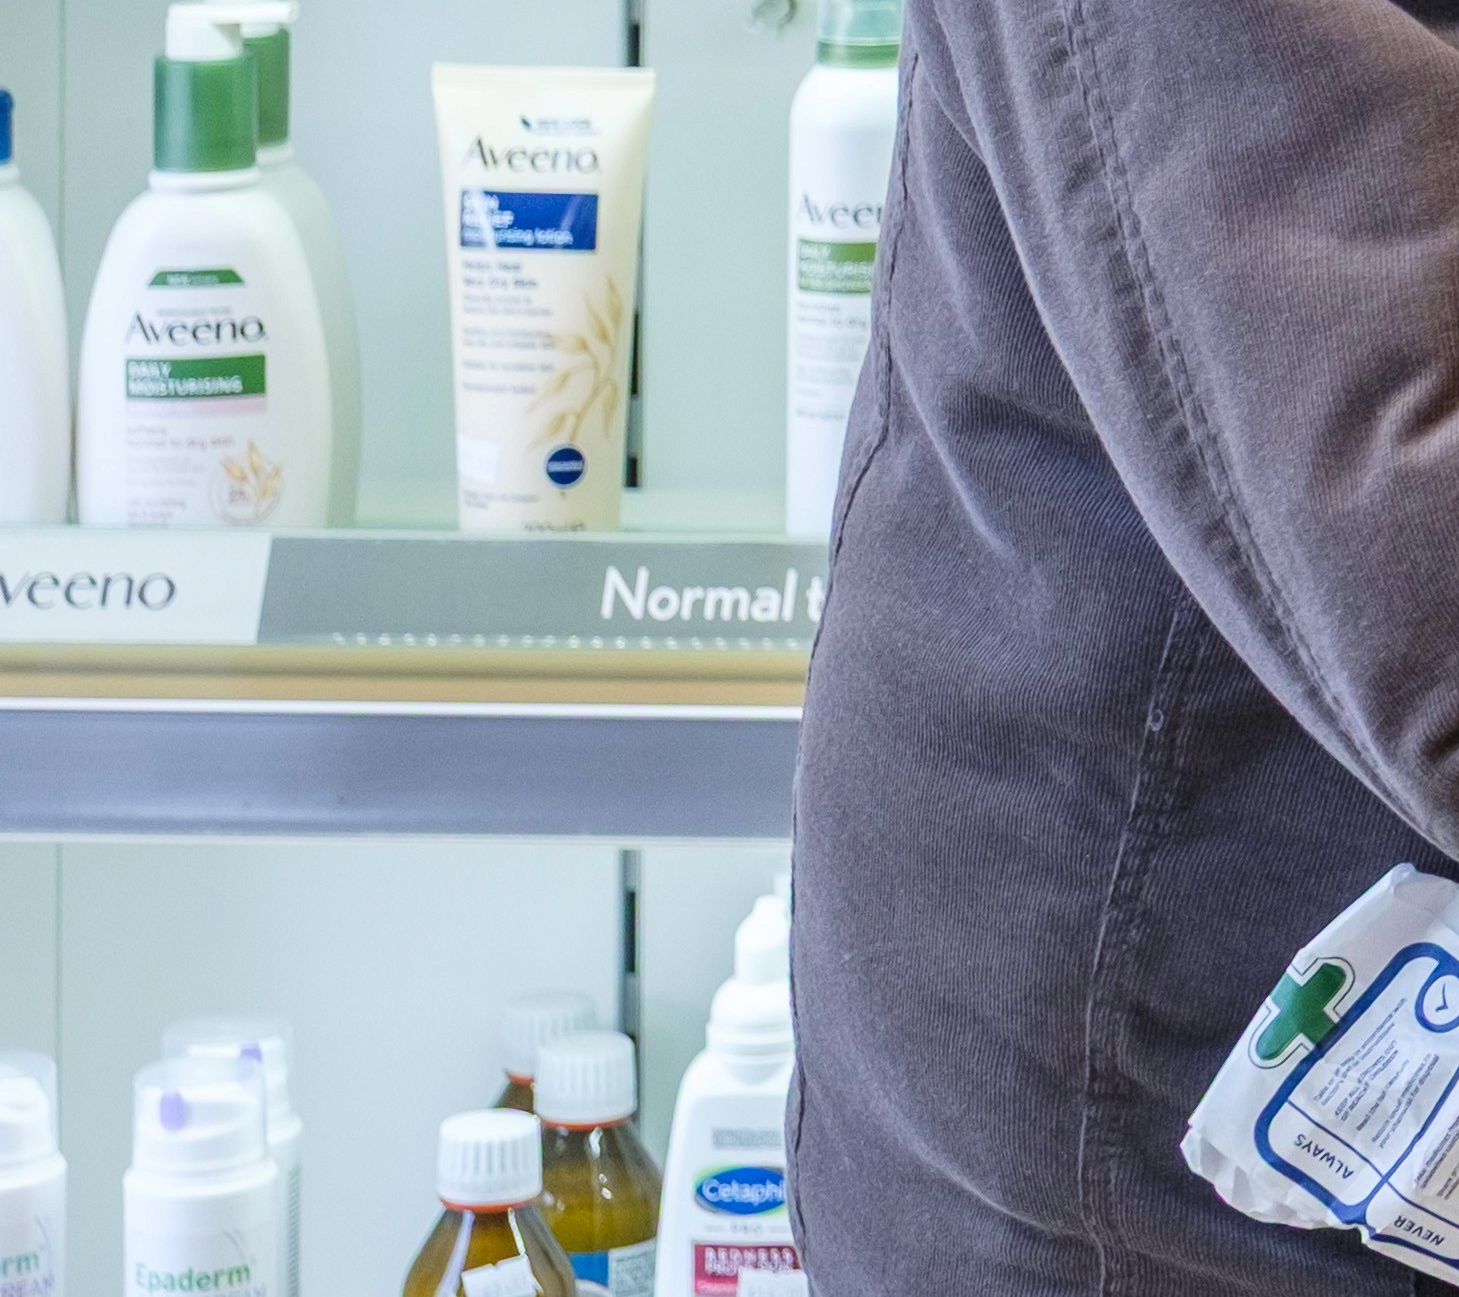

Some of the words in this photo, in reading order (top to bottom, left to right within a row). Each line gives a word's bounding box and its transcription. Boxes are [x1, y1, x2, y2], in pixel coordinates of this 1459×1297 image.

[461, 134, 600, 175] Aveeno
[125, 310, 266, 347] Aveeno
[0, 568, 177, 610] veeno
[600, 566, 796, 622] Normal
[1294, 1132, 1354, 1181] ALWAYS
[701, 1177, 785, 1206] Cetaphi
[1393, 1213, 1446, 1247] NEVER
[134, 1261, 251, 1293] Epaderm
